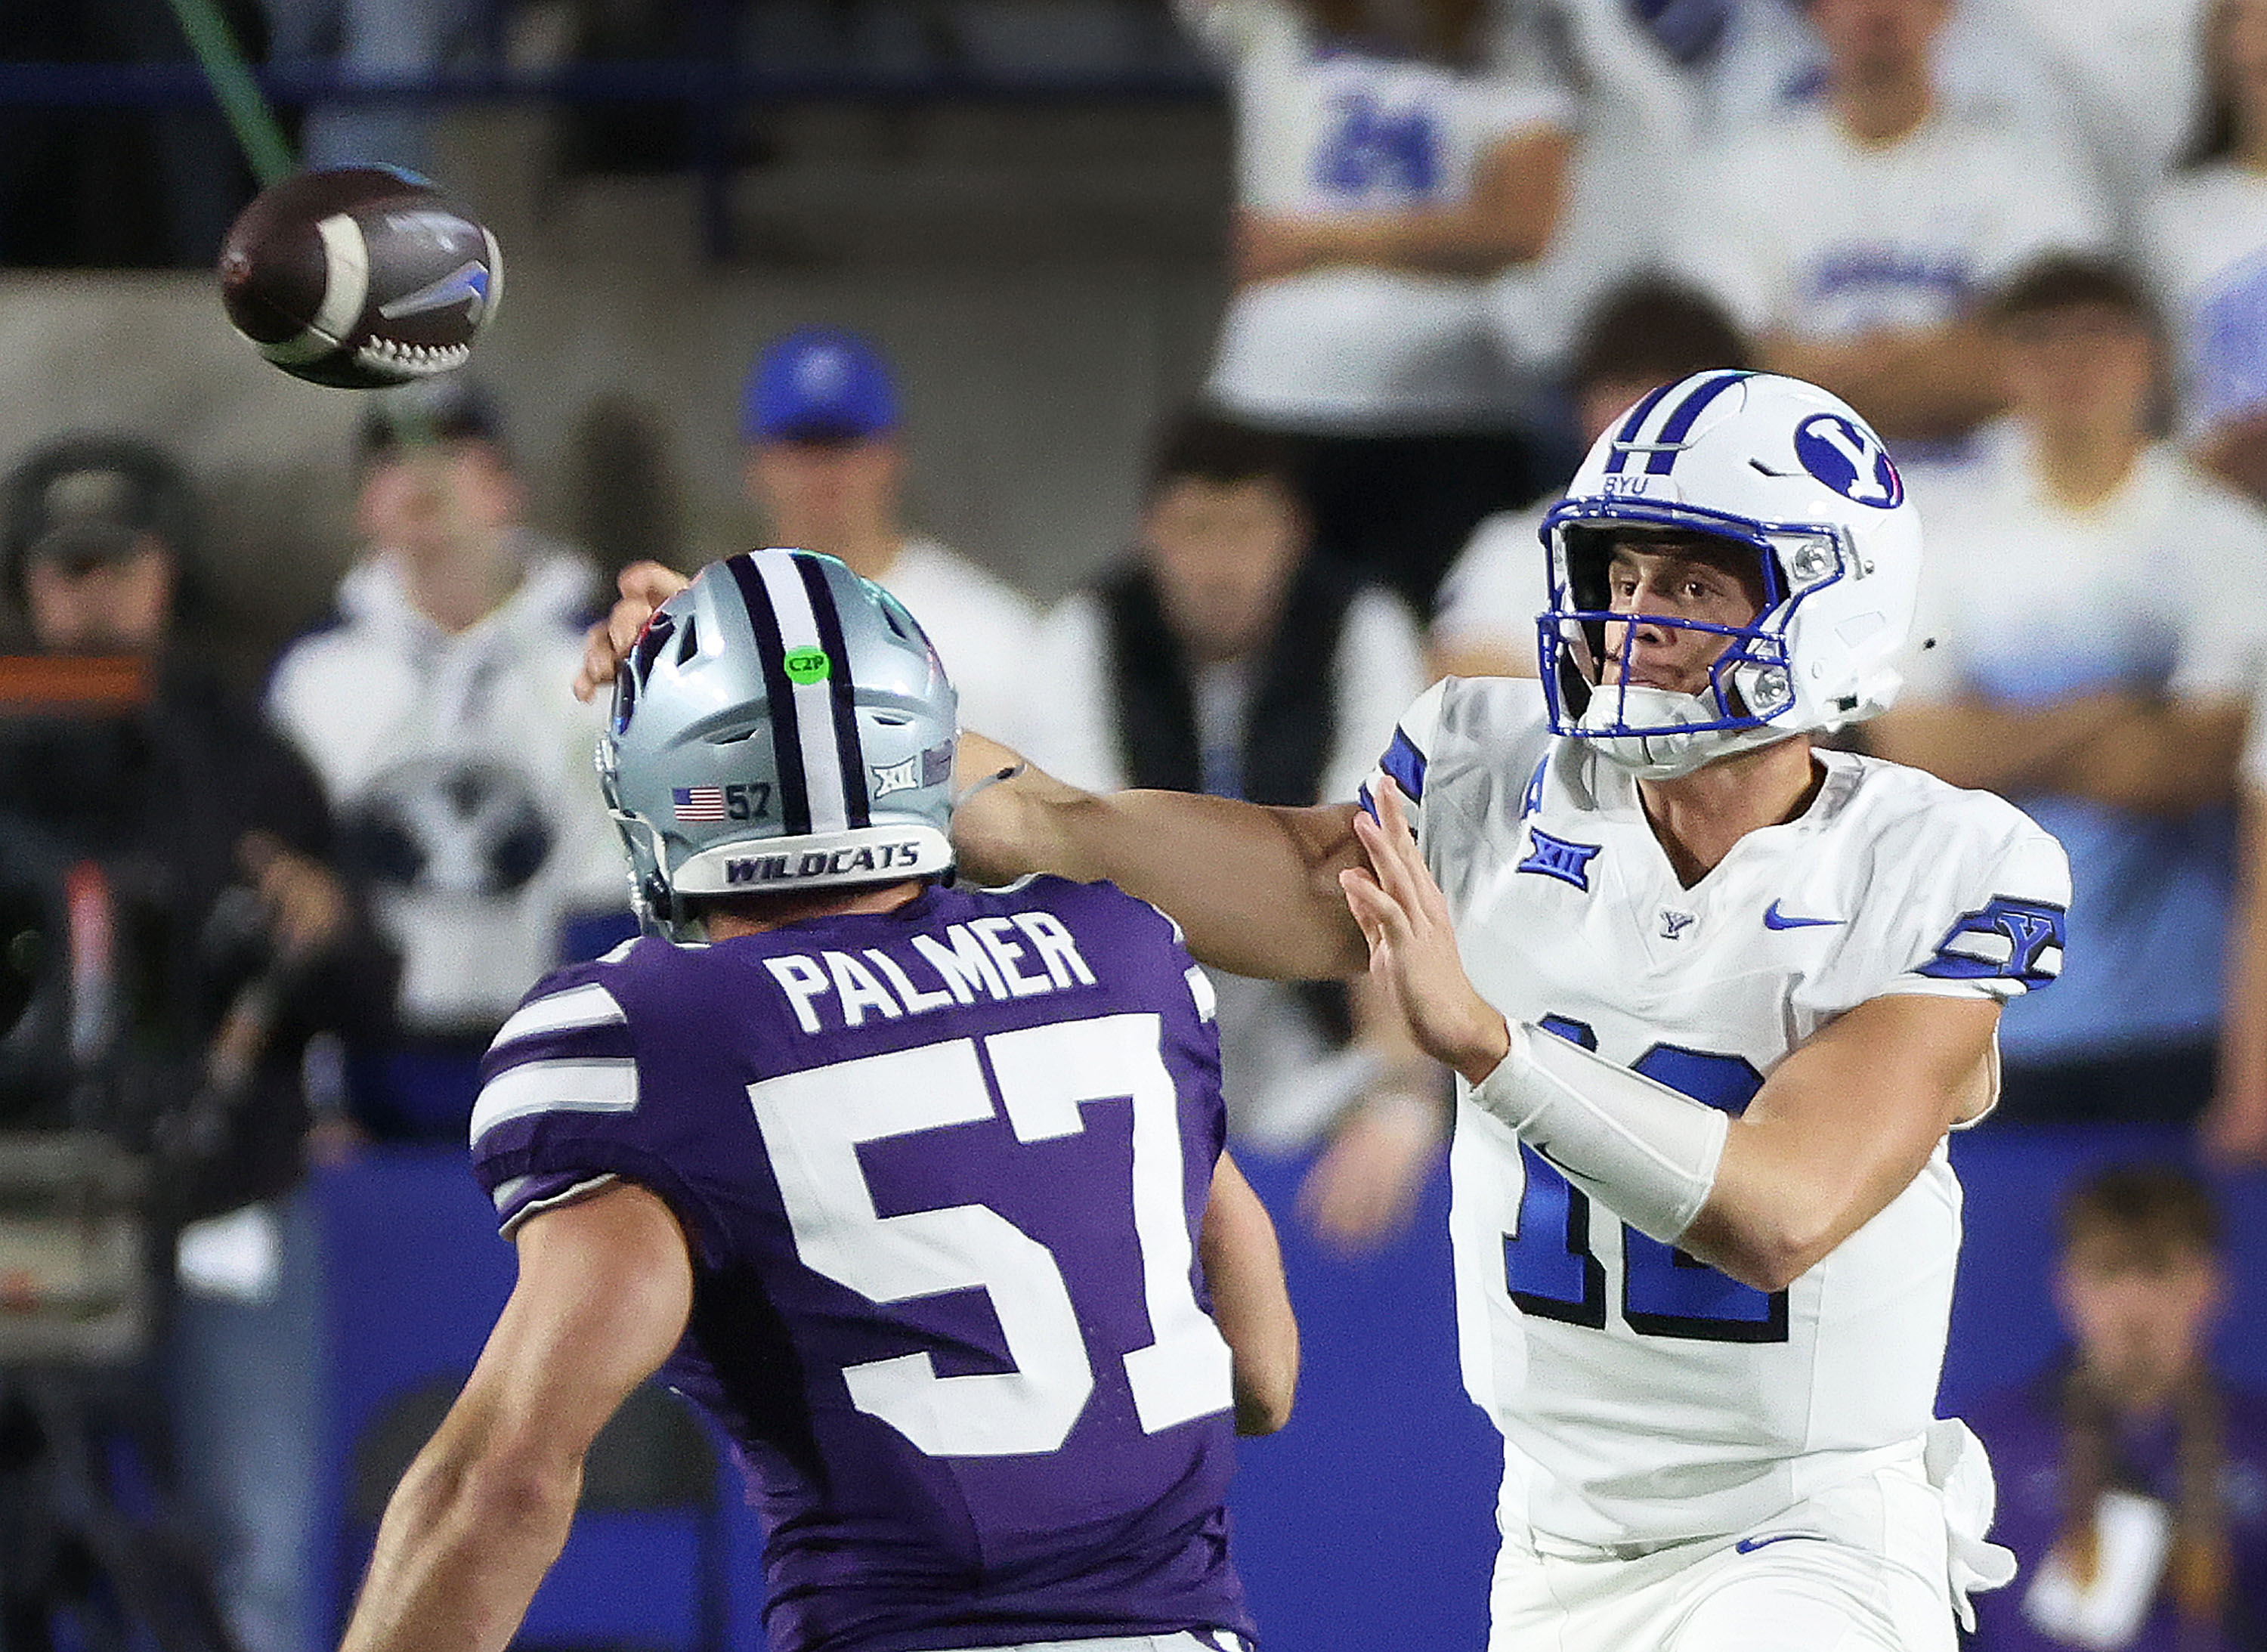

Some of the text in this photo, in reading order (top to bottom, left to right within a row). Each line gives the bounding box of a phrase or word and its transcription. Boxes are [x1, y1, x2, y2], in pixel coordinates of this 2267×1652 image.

[1604, 476, 1648, 495] BYU
[789, 654, 824, 672] C2P
[725, 781, 771, 820] 57
[725, 840, 920, 883] WILDCATS
[1993, 909, 2054, 976] Y
[762, 911, 1096, 1035] PALMER
[745, 1011, 1233, 1457] 57
